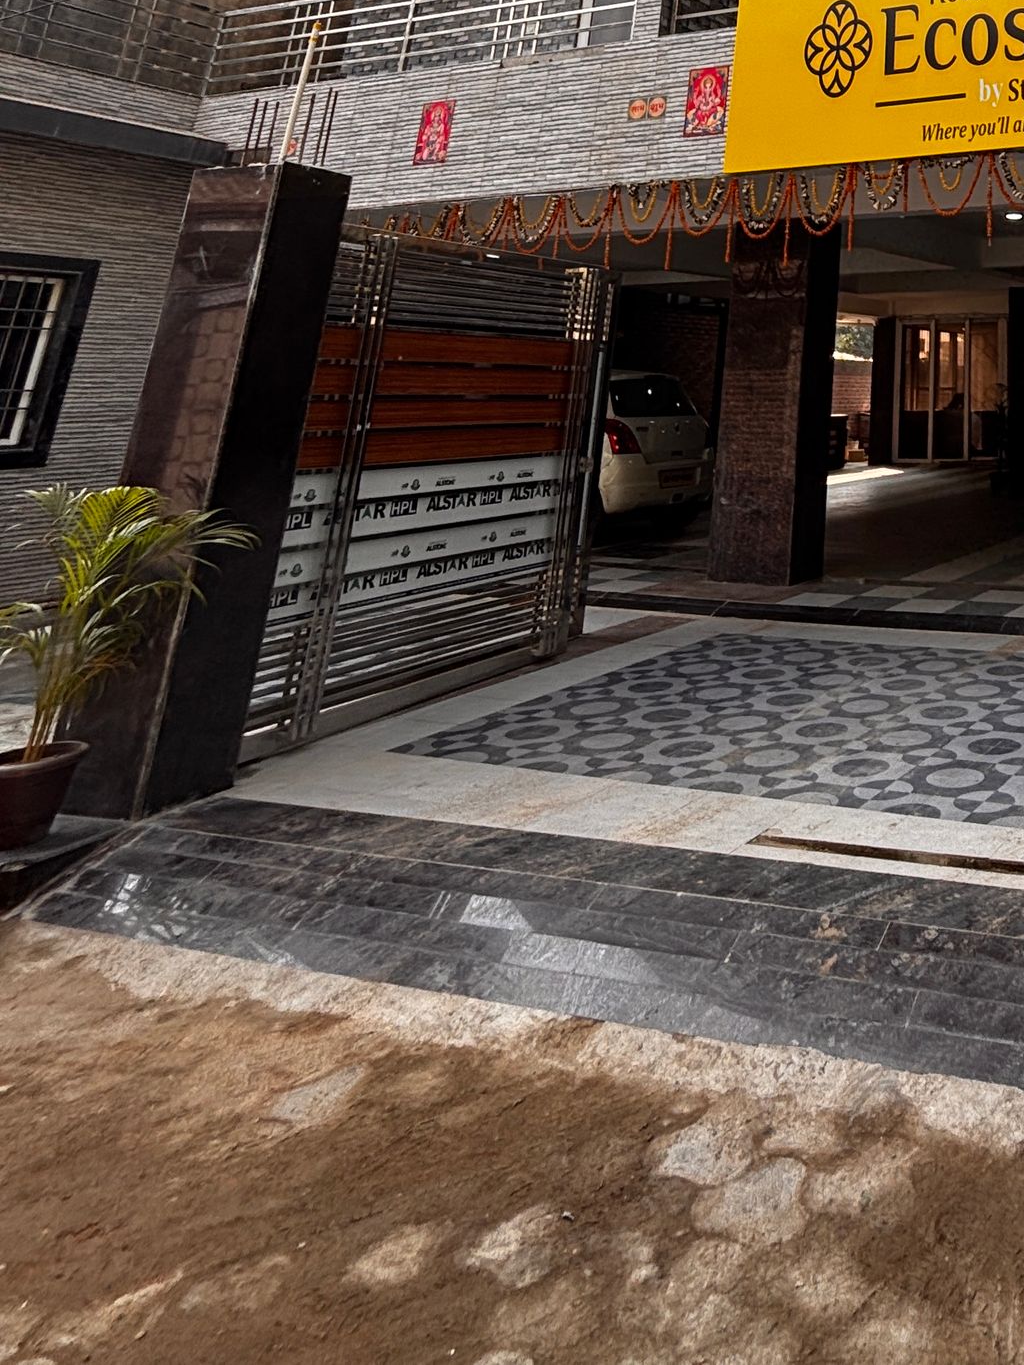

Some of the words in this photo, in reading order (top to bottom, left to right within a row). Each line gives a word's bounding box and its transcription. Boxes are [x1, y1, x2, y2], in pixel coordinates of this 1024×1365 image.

[979, 78, 1004, 107] by
[921, 123, 967, 142] Where
[968, 116, 1009, 142] you'll
[390, 498, 418, 517] HPL
[426, 491, 477, 512] ALSTAR
[480, 489, 502, 506] HPL
[509, 484, 551, 502] ALSTAR
[380, 569, 407, 587] HPL
[416, 556, 469, 579] ALSTAR
[472, 552, 495, 568] HPL
[502, 542, 544, 562] ALSTAR
